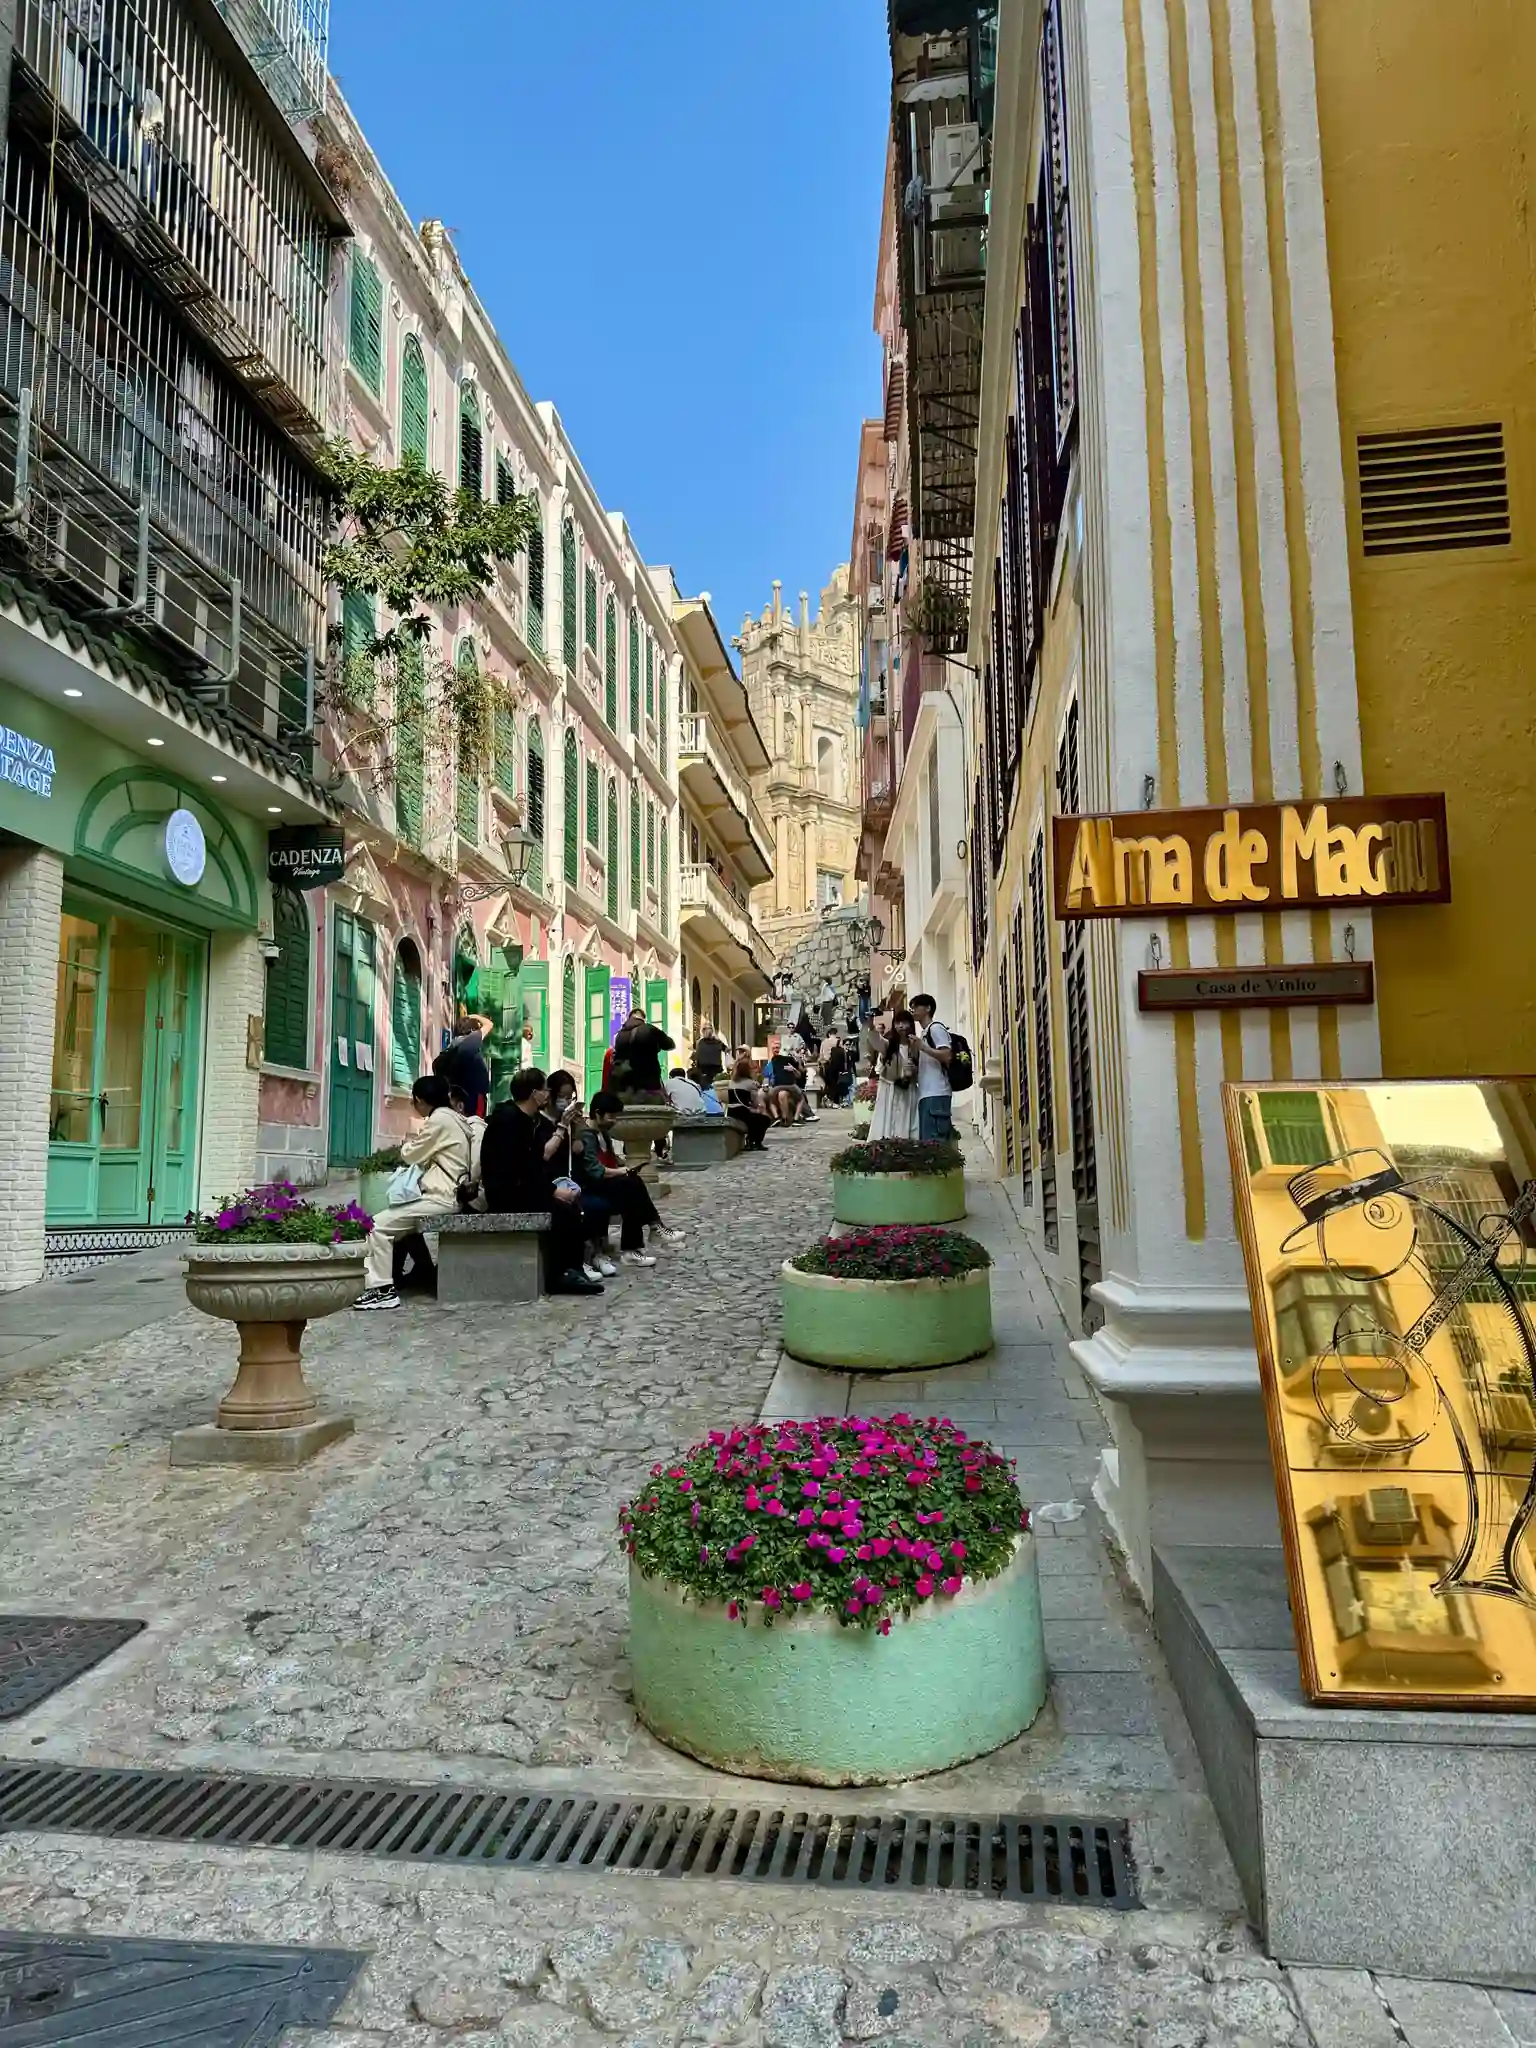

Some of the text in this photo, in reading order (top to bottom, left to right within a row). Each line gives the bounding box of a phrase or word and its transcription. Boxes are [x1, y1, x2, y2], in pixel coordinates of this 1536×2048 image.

[269, 848, 343, 867] CADENZA
[1065, 803, 1441, 908] Alma de Macau
[1196, 978, 1318, 996] Casa de Vinho
